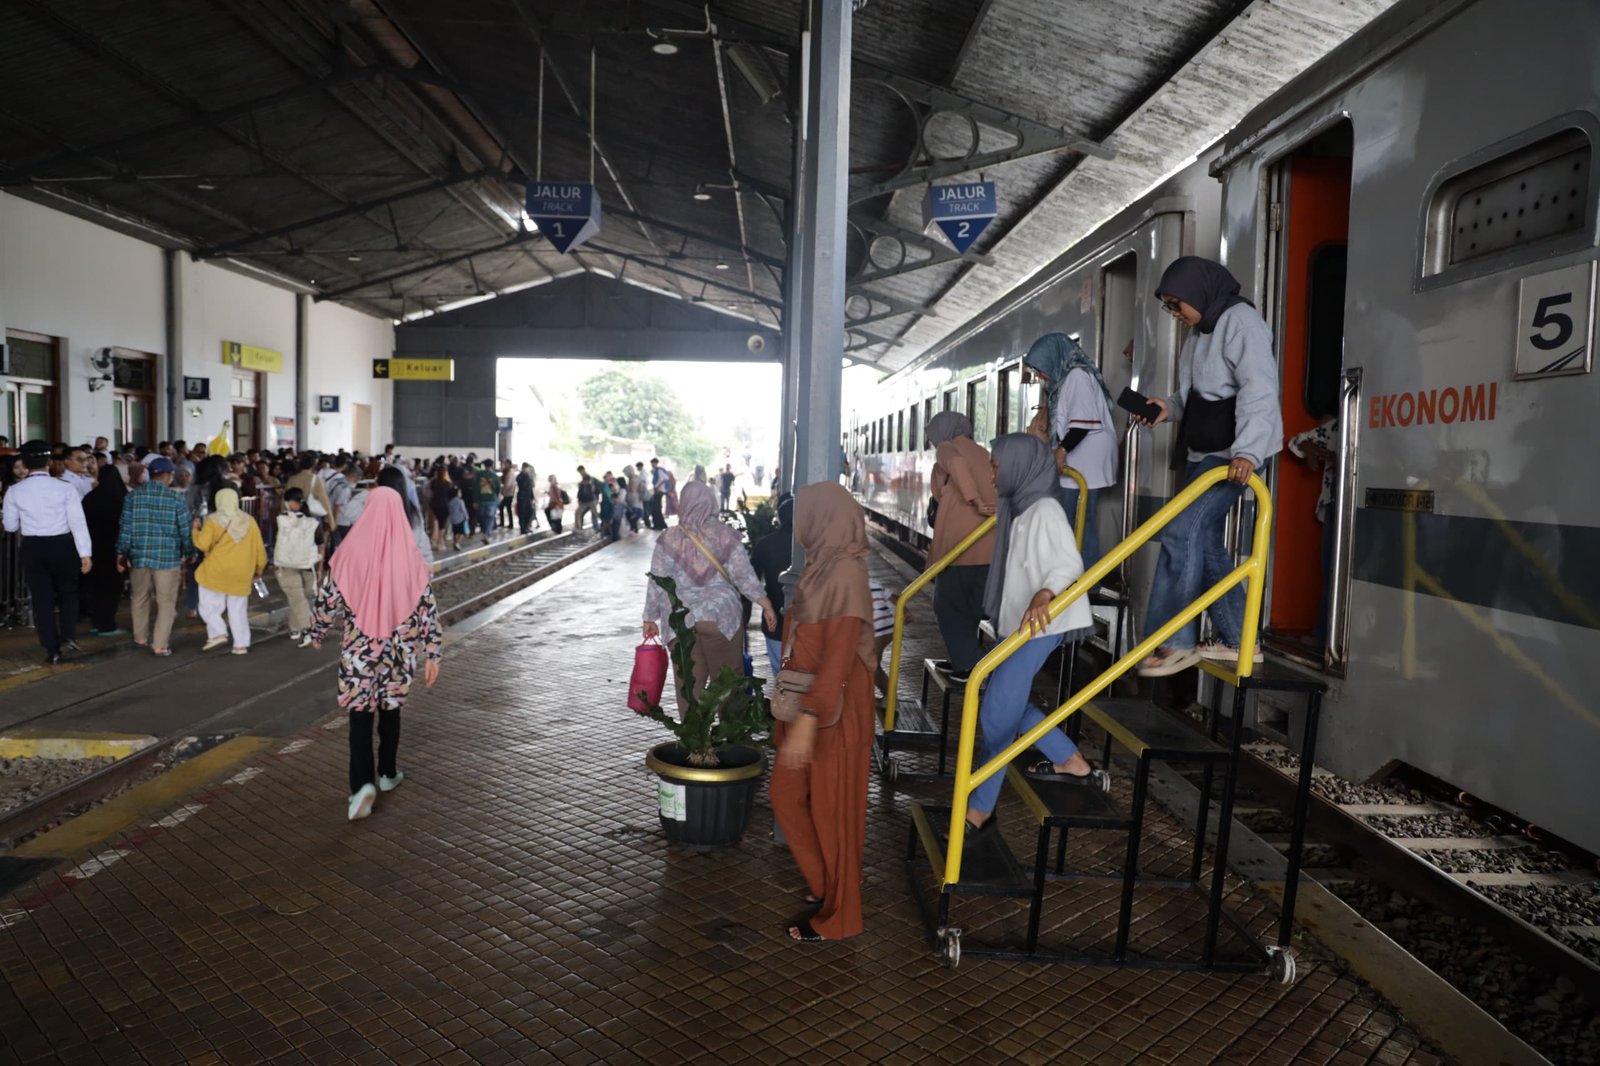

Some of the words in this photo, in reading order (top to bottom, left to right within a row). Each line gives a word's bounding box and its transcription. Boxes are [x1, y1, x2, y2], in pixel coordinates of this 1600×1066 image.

[533, 185, 581, 199] JALUR
[938, 185, 986, 201] JALUR
[543, 201, 574, 212] TRACK
[949, 202, 980, 213] TRACK
[552, 222, 566, 238] 1
[957, 222, 970, 238] 2
[1529, 292, 1574, 350] 5
[406, 363, 443, 372] Keluar
[1368, 382, 1497, 429] EKONOMI
